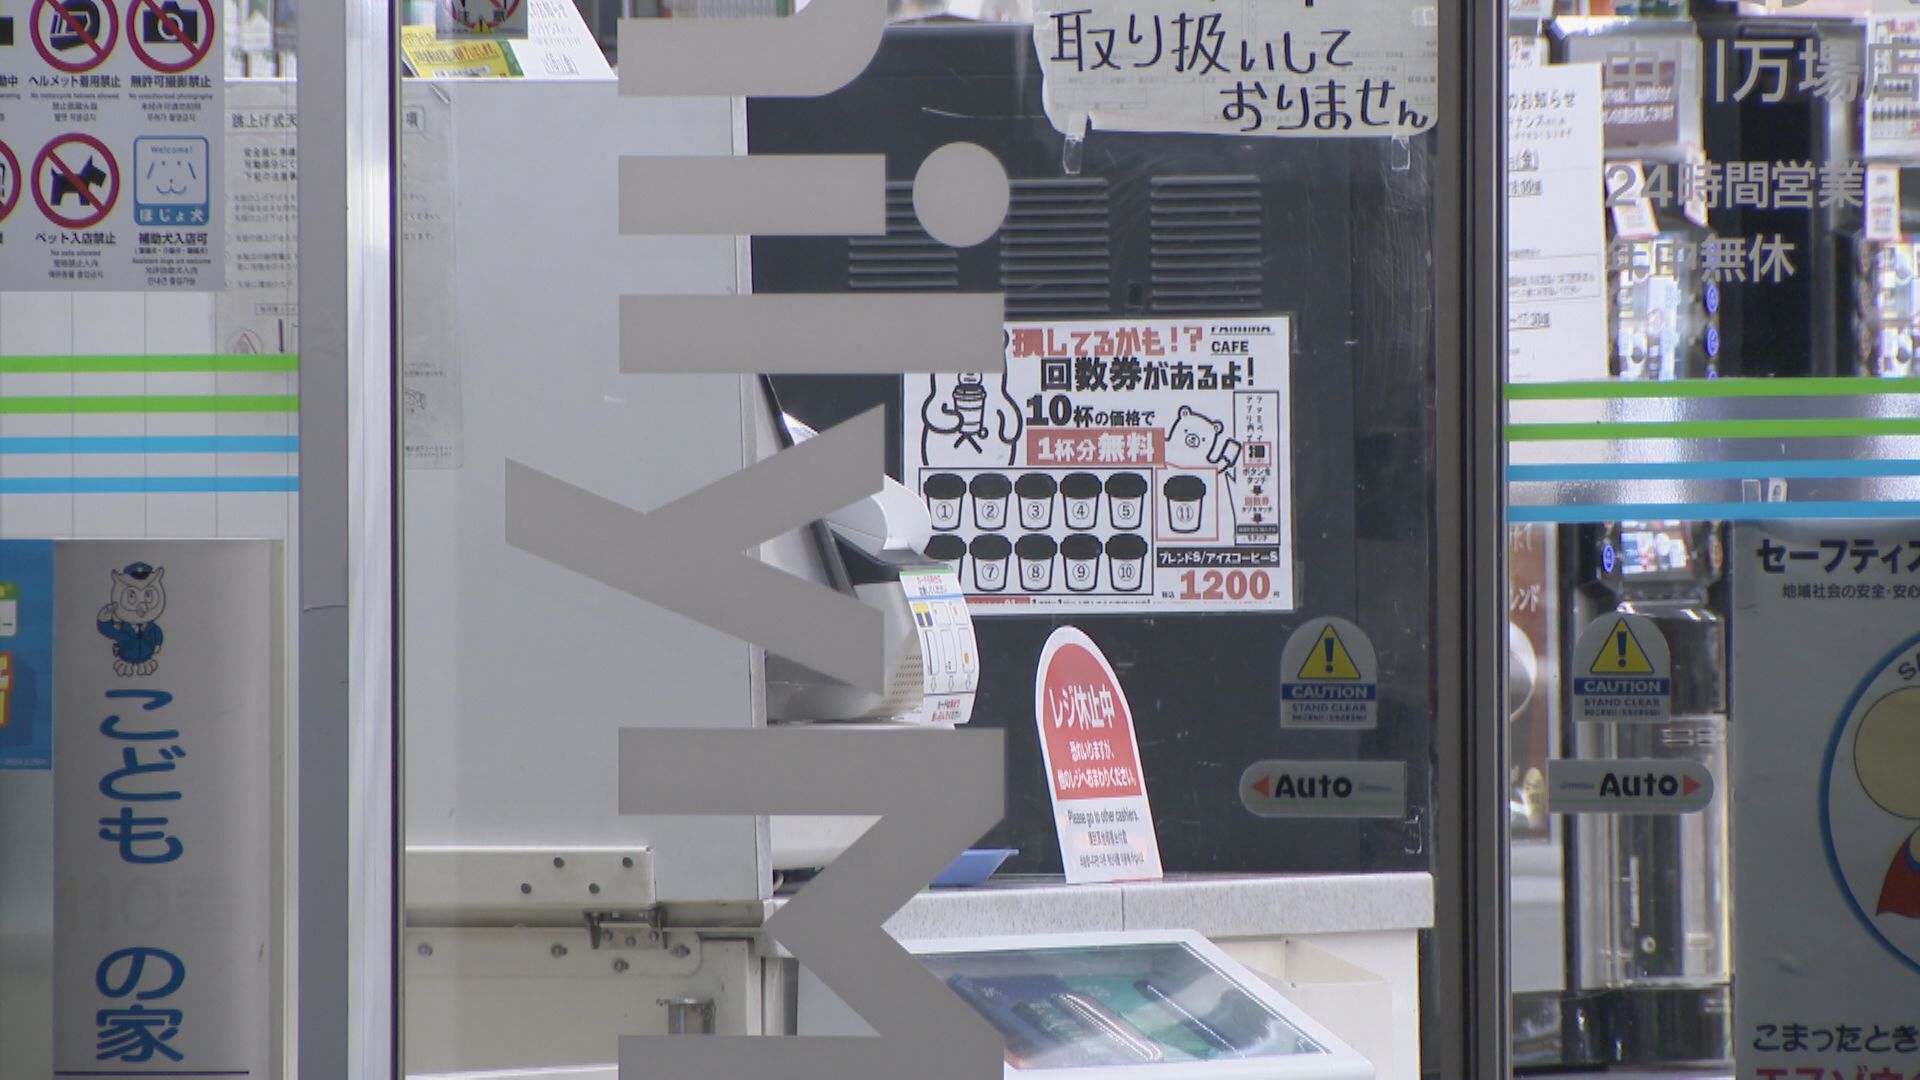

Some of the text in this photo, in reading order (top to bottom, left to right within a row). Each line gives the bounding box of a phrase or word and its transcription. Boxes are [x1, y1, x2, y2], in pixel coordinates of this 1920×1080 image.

[1050, 9, 1353, 74] 取り扱いして
[29, 75, 121, 88] ヘルメット着用禁止
[131, 75, 211, 88] 無許可撮影禁止
[1219, 79, 1429, 132] おりません
[151, 145, 193, 153] Welcome!
[1605, 160, 1865, 209] 24時間営業
[140, 208, 204, 222] ほじょ犬
[35, 232, 117, 245] ペット入店禁止
[138, 233, 208, 245] 補助犬入店可
[1606, 233, 1796, 283] 年中無休
[1211, 341, 1249, 353] CAFE
[1041, 357, 1255, 392] 回数券があるよ!
[1026, 394, 1156, 427] 10杯の価格で
[1038, 431, 1156, 463] 1杯分無料
[1292, 686, 1367, 698] CAUTION
[1584, 681, 1661, 693] CAUTION
[1049, 682, 1116, 731] レジ休止中
[1292, 703, 1367, 712] STAND CLEAR
[1584, 698, 1661, 707] STAND CLEAR
[98, 688, 187, 865] こども
[1275, 774, 1352, 798] Auto
[1600, 772, 1678, 797] Auto
[1068, 809, 1086, 825] Please
[1086, 811, 1094, 828] go
[1100, 808, 1115, 824] other
[96, 946, 185, 1062] の家
[1753, 1023, 1919, 1052] こまったとき
